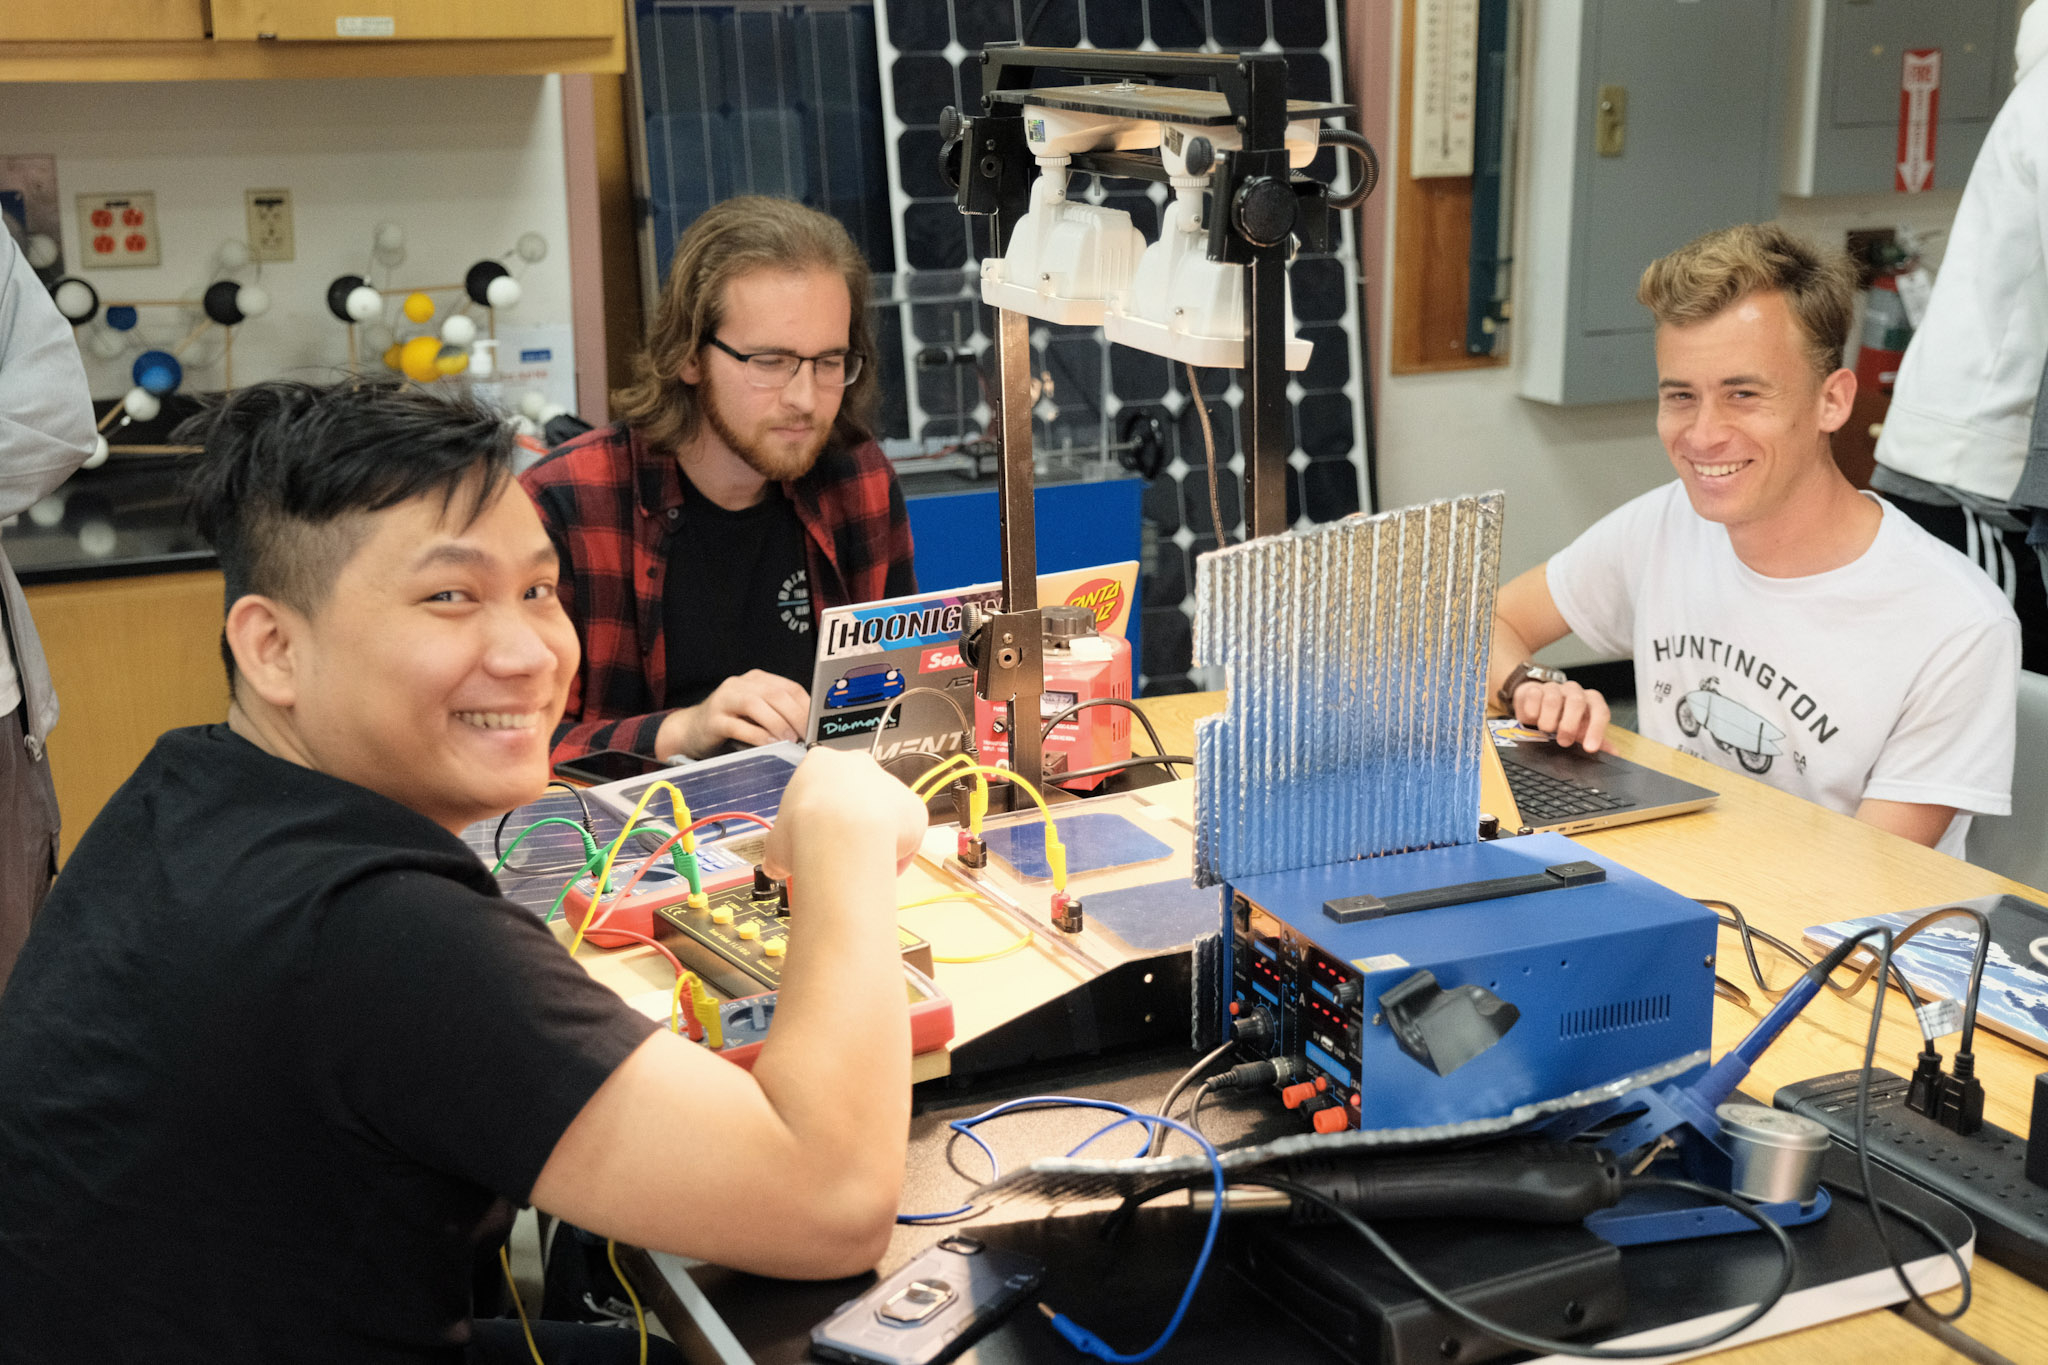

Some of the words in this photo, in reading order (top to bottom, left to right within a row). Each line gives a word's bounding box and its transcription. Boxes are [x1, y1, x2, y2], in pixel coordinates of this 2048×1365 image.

[928, 651, 968, 669] Sen
[1653, 634, 1839, 744] HUNTINGTON
[1654, 680, 1672, 695] HB
[823, 710, 897, 735] Diamon
[1793, 751, 1807, 769] CA
